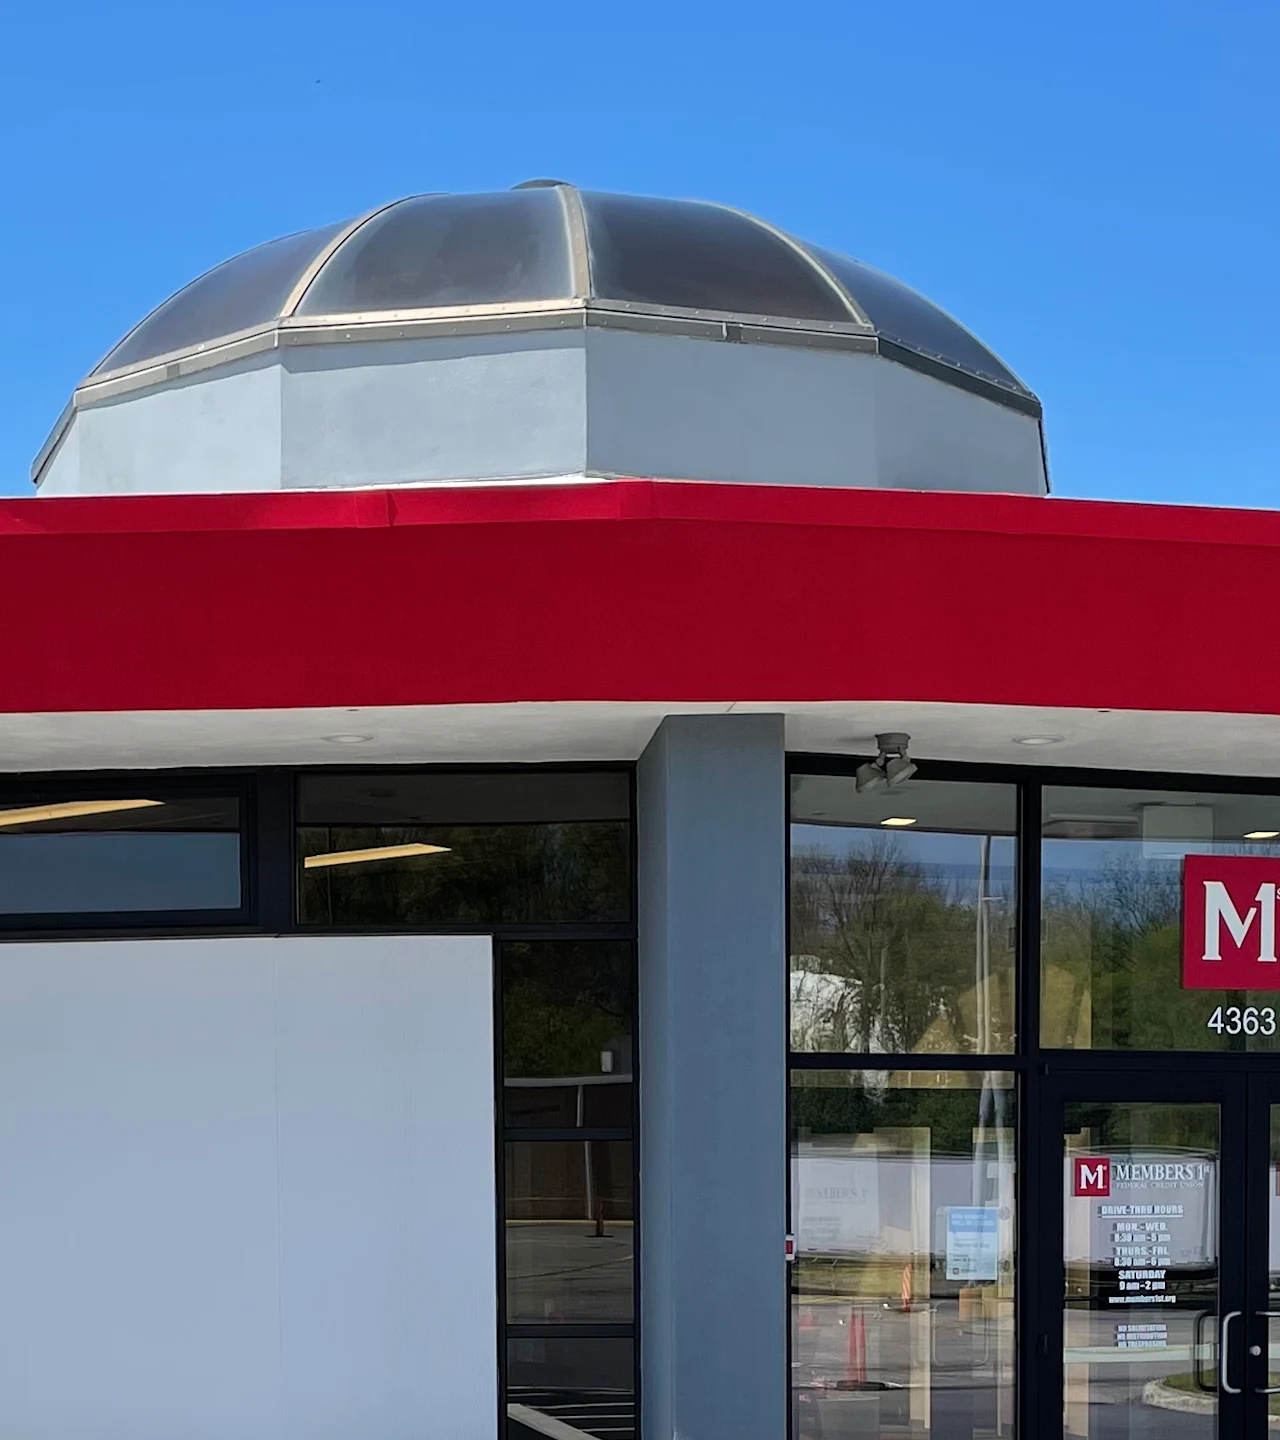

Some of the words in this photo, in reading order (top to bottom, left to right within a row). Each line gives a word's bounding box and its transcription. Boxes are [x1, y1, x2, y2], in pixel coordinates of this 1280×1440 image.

[1207, 1006, 1276, 1035] 4363
[1117, 1164, 1193, 1180] MEMBERS
[1102, 1205, 1152, 1215] DRIVE-THRU
[1154, 1205, 1183, 1214] HOURS
[1118, 1270, 1166, 1280] SATURDAY
[1119, 1281, 1126, 1290] 9
[1152, 1281, 1166, 1291] pm
